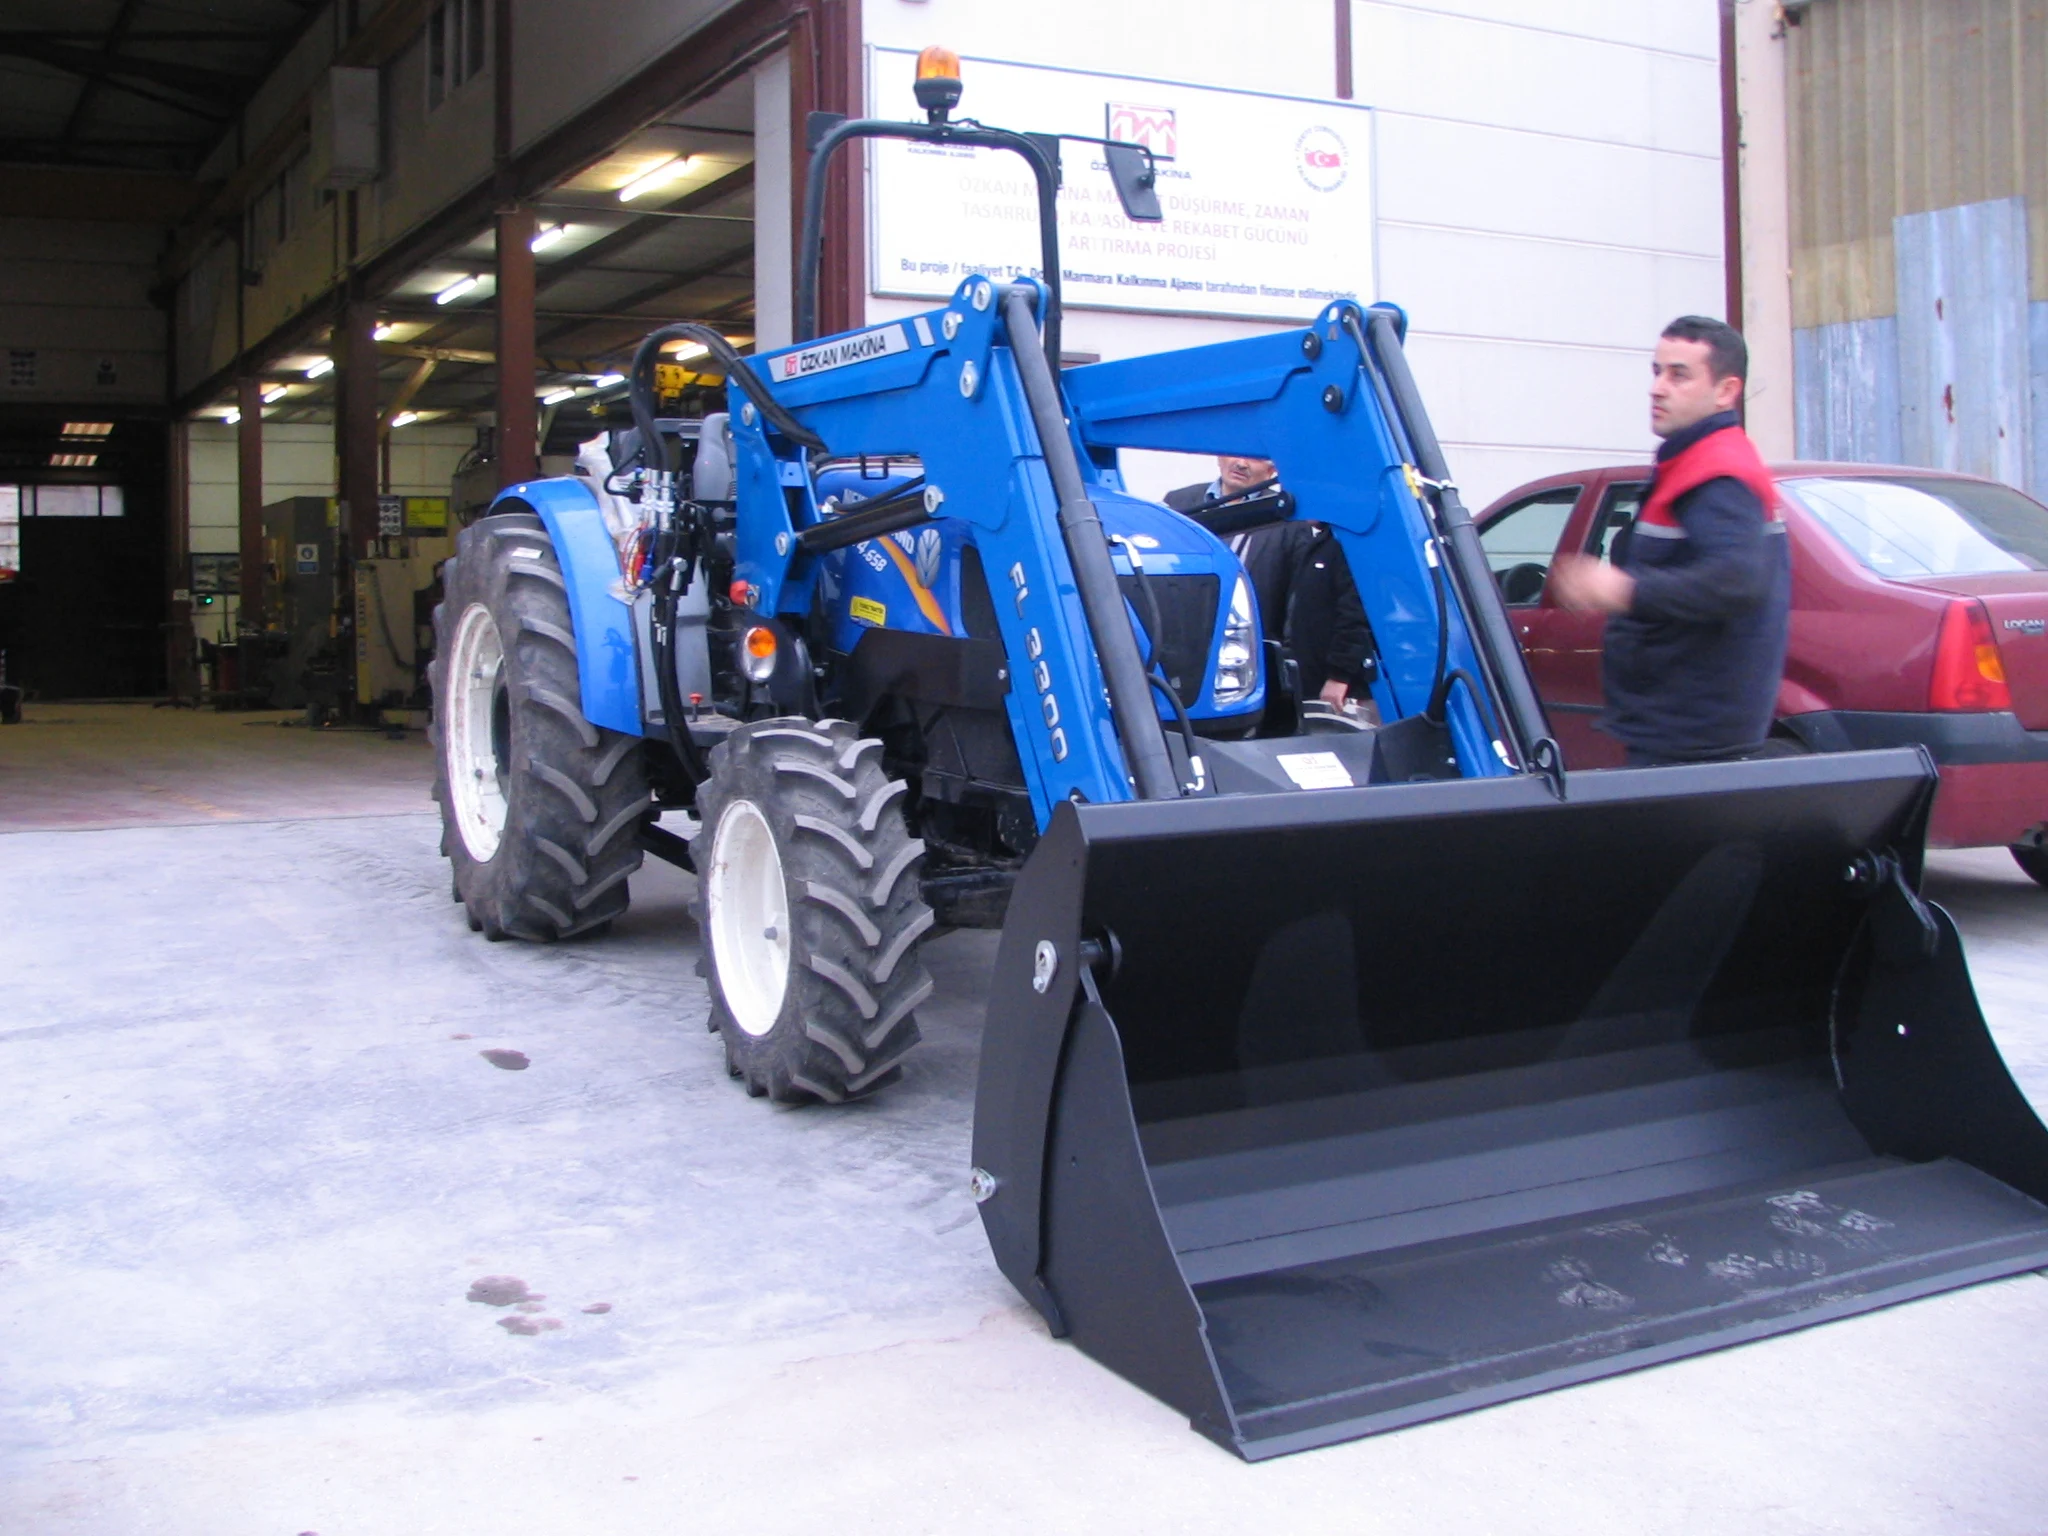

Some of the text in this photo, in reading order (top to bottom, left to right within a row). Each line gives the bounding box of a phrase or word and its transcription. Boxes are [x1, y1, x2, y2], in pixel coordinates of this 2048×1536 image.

[1155, 167, 1192, 180] AKİNA
[959, 175, 1018, 197] ÖZKAN
[1254, 203, 1310, 223] ZAMAN
[1173, 219, 1240, 240] REKABET
[1157, 241, 1217, 261] PROJESİ
[901, 258, 916, 271] Bu
[920, 261, 949, 275] proje
[1063, 270, 1113, 285] Marmara
[800, 335, 887, 373] ÖZKAN MAKİNA
[2003, 619, 2045, 630] LOGAN
[1008, 561, 1068, 763] FL 3300
